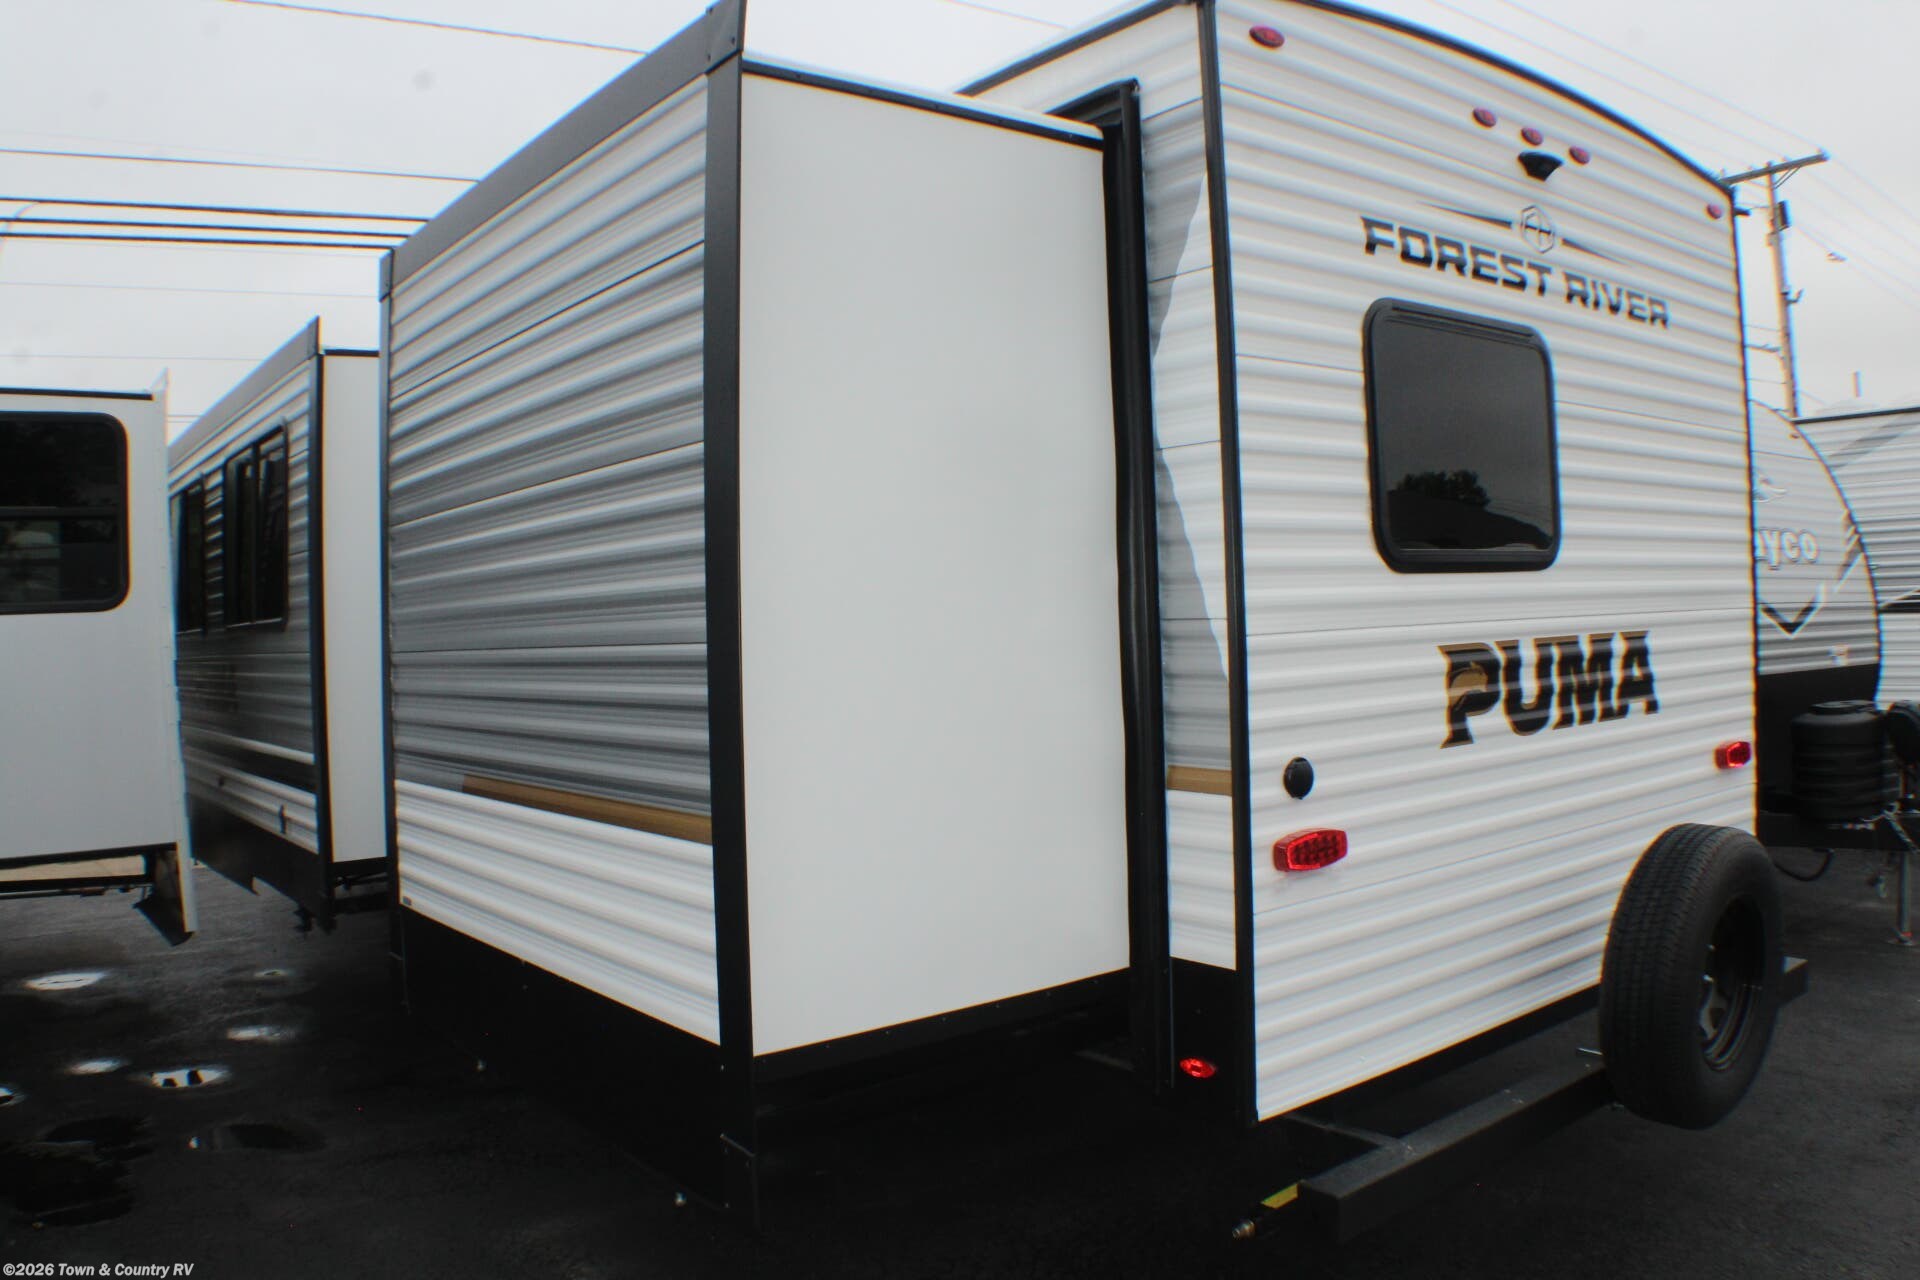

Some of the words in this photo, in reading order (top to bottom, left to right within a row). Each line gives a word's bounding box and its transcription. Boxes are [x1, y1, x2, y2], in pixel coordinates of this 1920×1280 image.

[1361, 216, 1553, 296] FOREST
[1563, 270, 1670, 328] RIVER
[1437, 630, 1660, 749] PUMA
